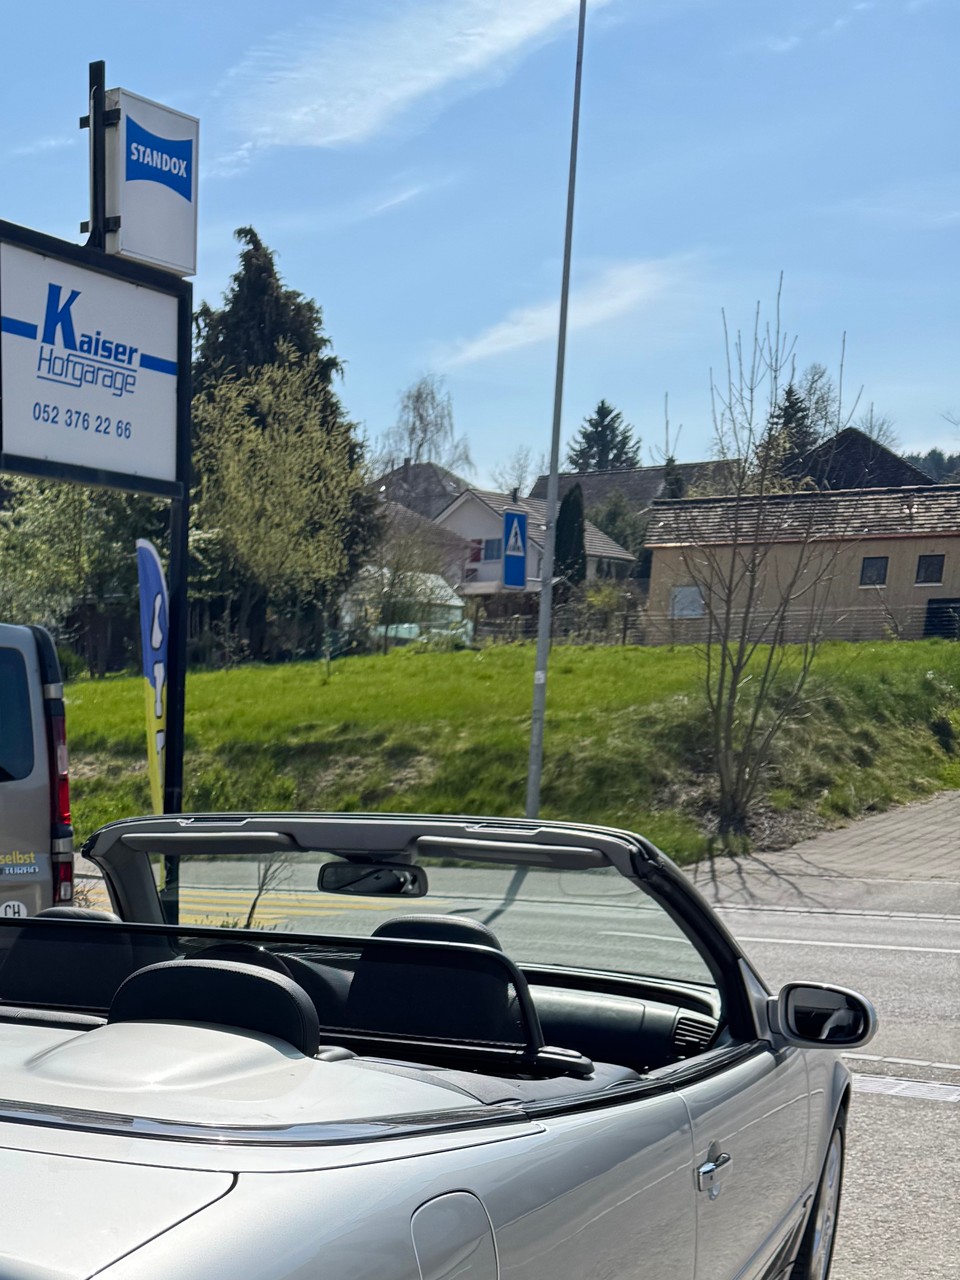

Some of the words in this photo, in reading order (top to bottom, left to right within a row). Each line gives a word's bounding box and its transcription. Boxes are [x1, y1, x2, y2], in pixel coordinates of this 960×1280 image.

[130, 142, 187, 178] STANDOX
[41, 282, 138, 365] Kaiser
[37, 345, 137, 397] Hofgarage
[32, 402, 60, 424] 052
[64, 408, 90, 431] 376
[94, 415, 112, 435] 22
[115, 419, 132, 439] 66
[0, 850, 37, 865] selbst
[4, 904, 21, 917] CH
